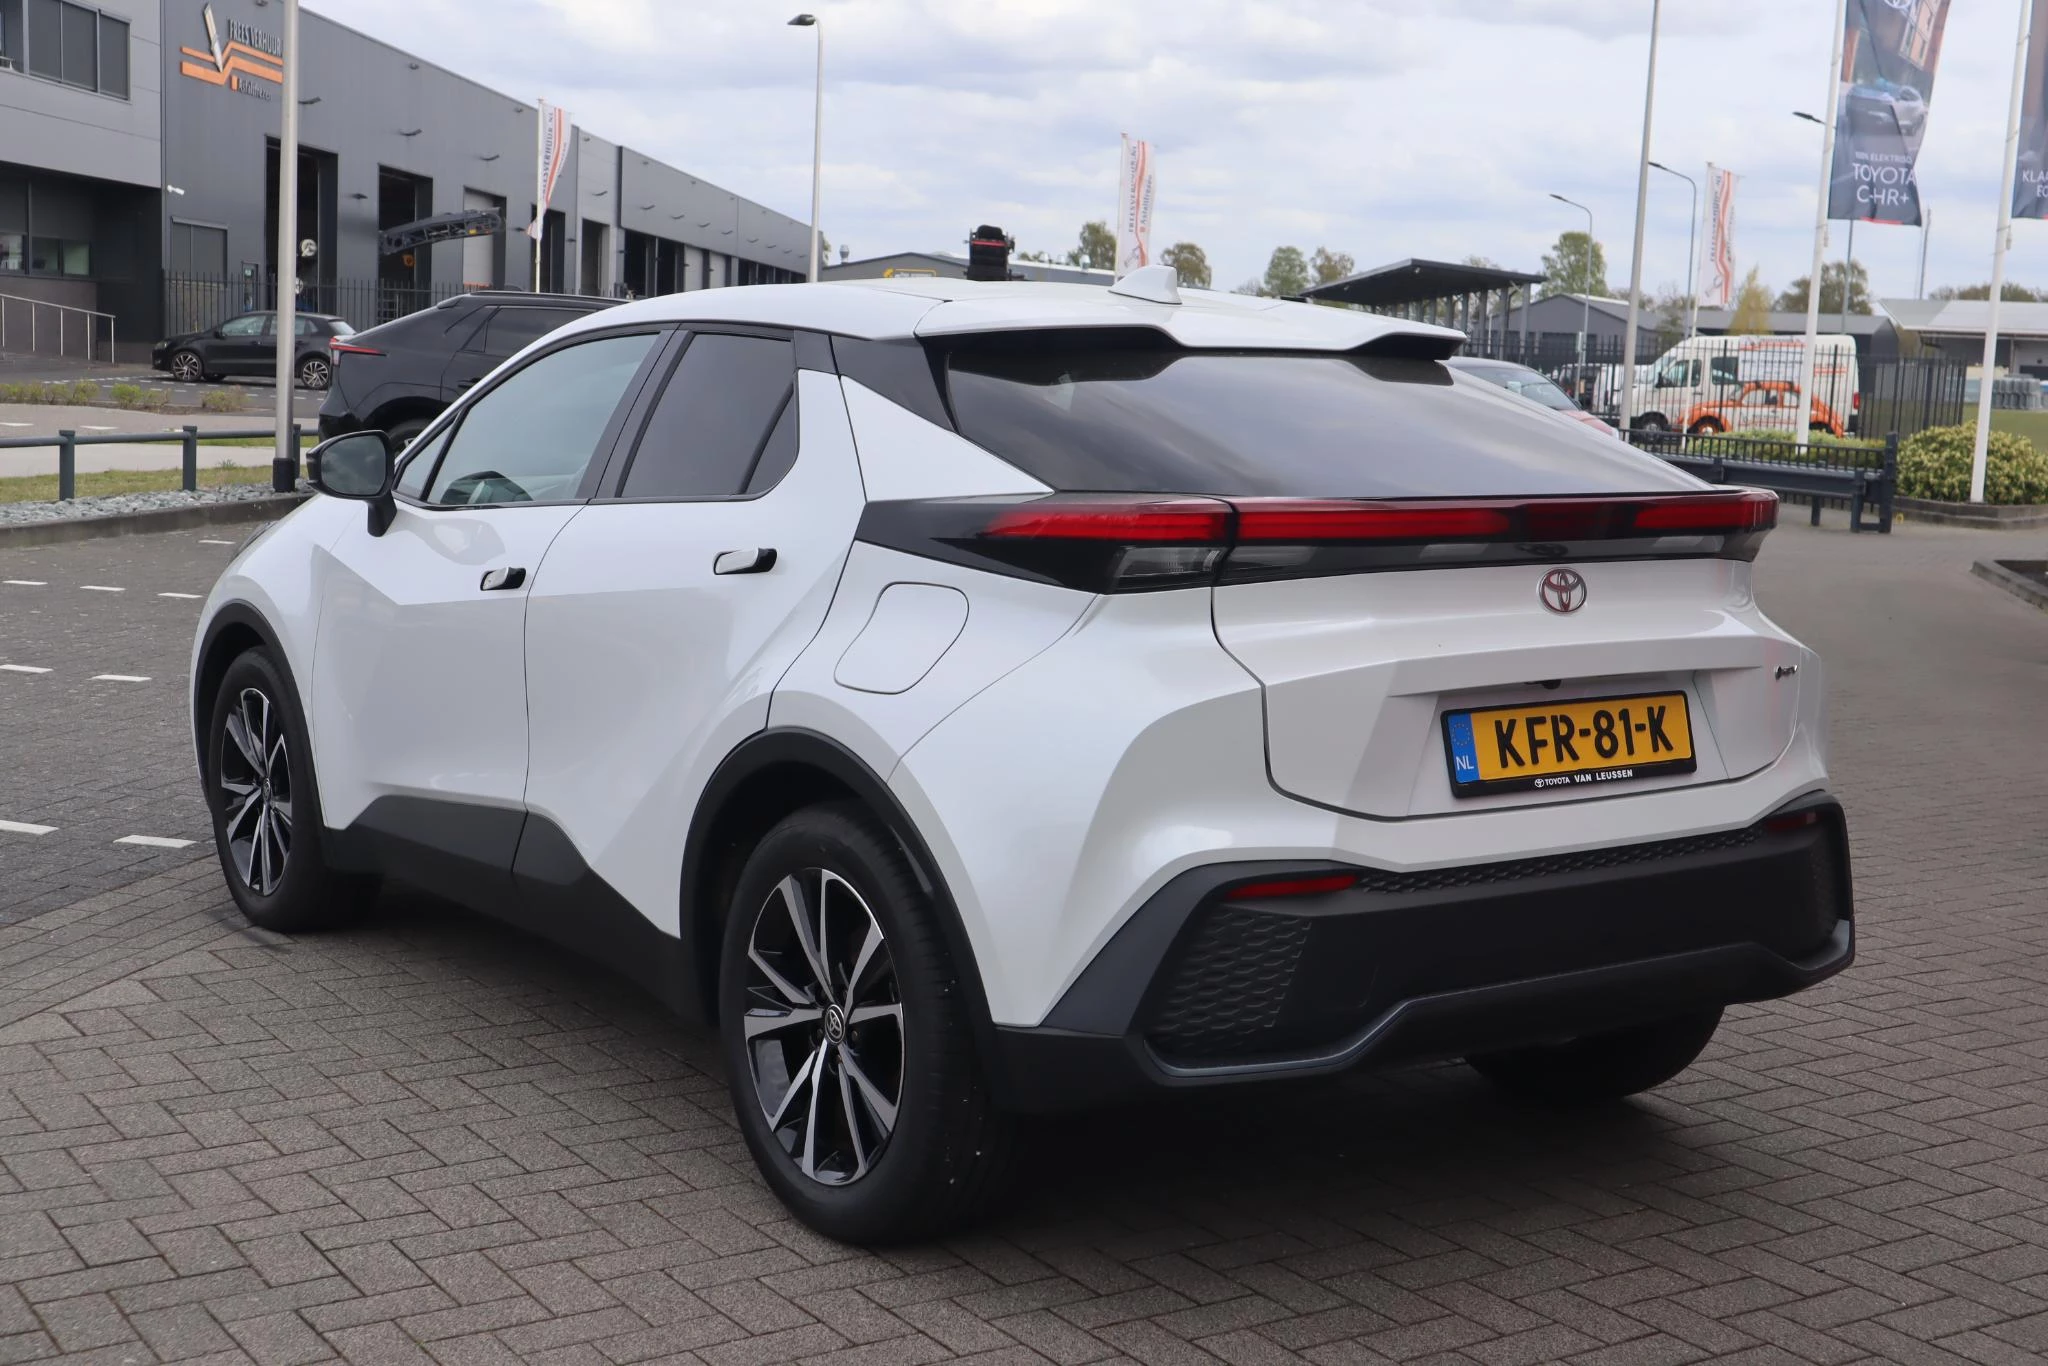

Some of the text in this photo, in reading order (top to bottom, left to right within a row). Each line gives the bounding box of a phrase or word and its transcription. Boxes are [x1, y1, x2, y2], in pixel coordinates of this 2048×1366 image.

[1852, 162, 1918, 185] TOYOTA
[1856, 184, 1910, 206] C-HR+
[1494, 705, 1674, 769] KFR-81-K
[1455, 755, 1475, 771] NL
[1544, 769, 1633, 786] TOYOTA VAN LEUSSEN
